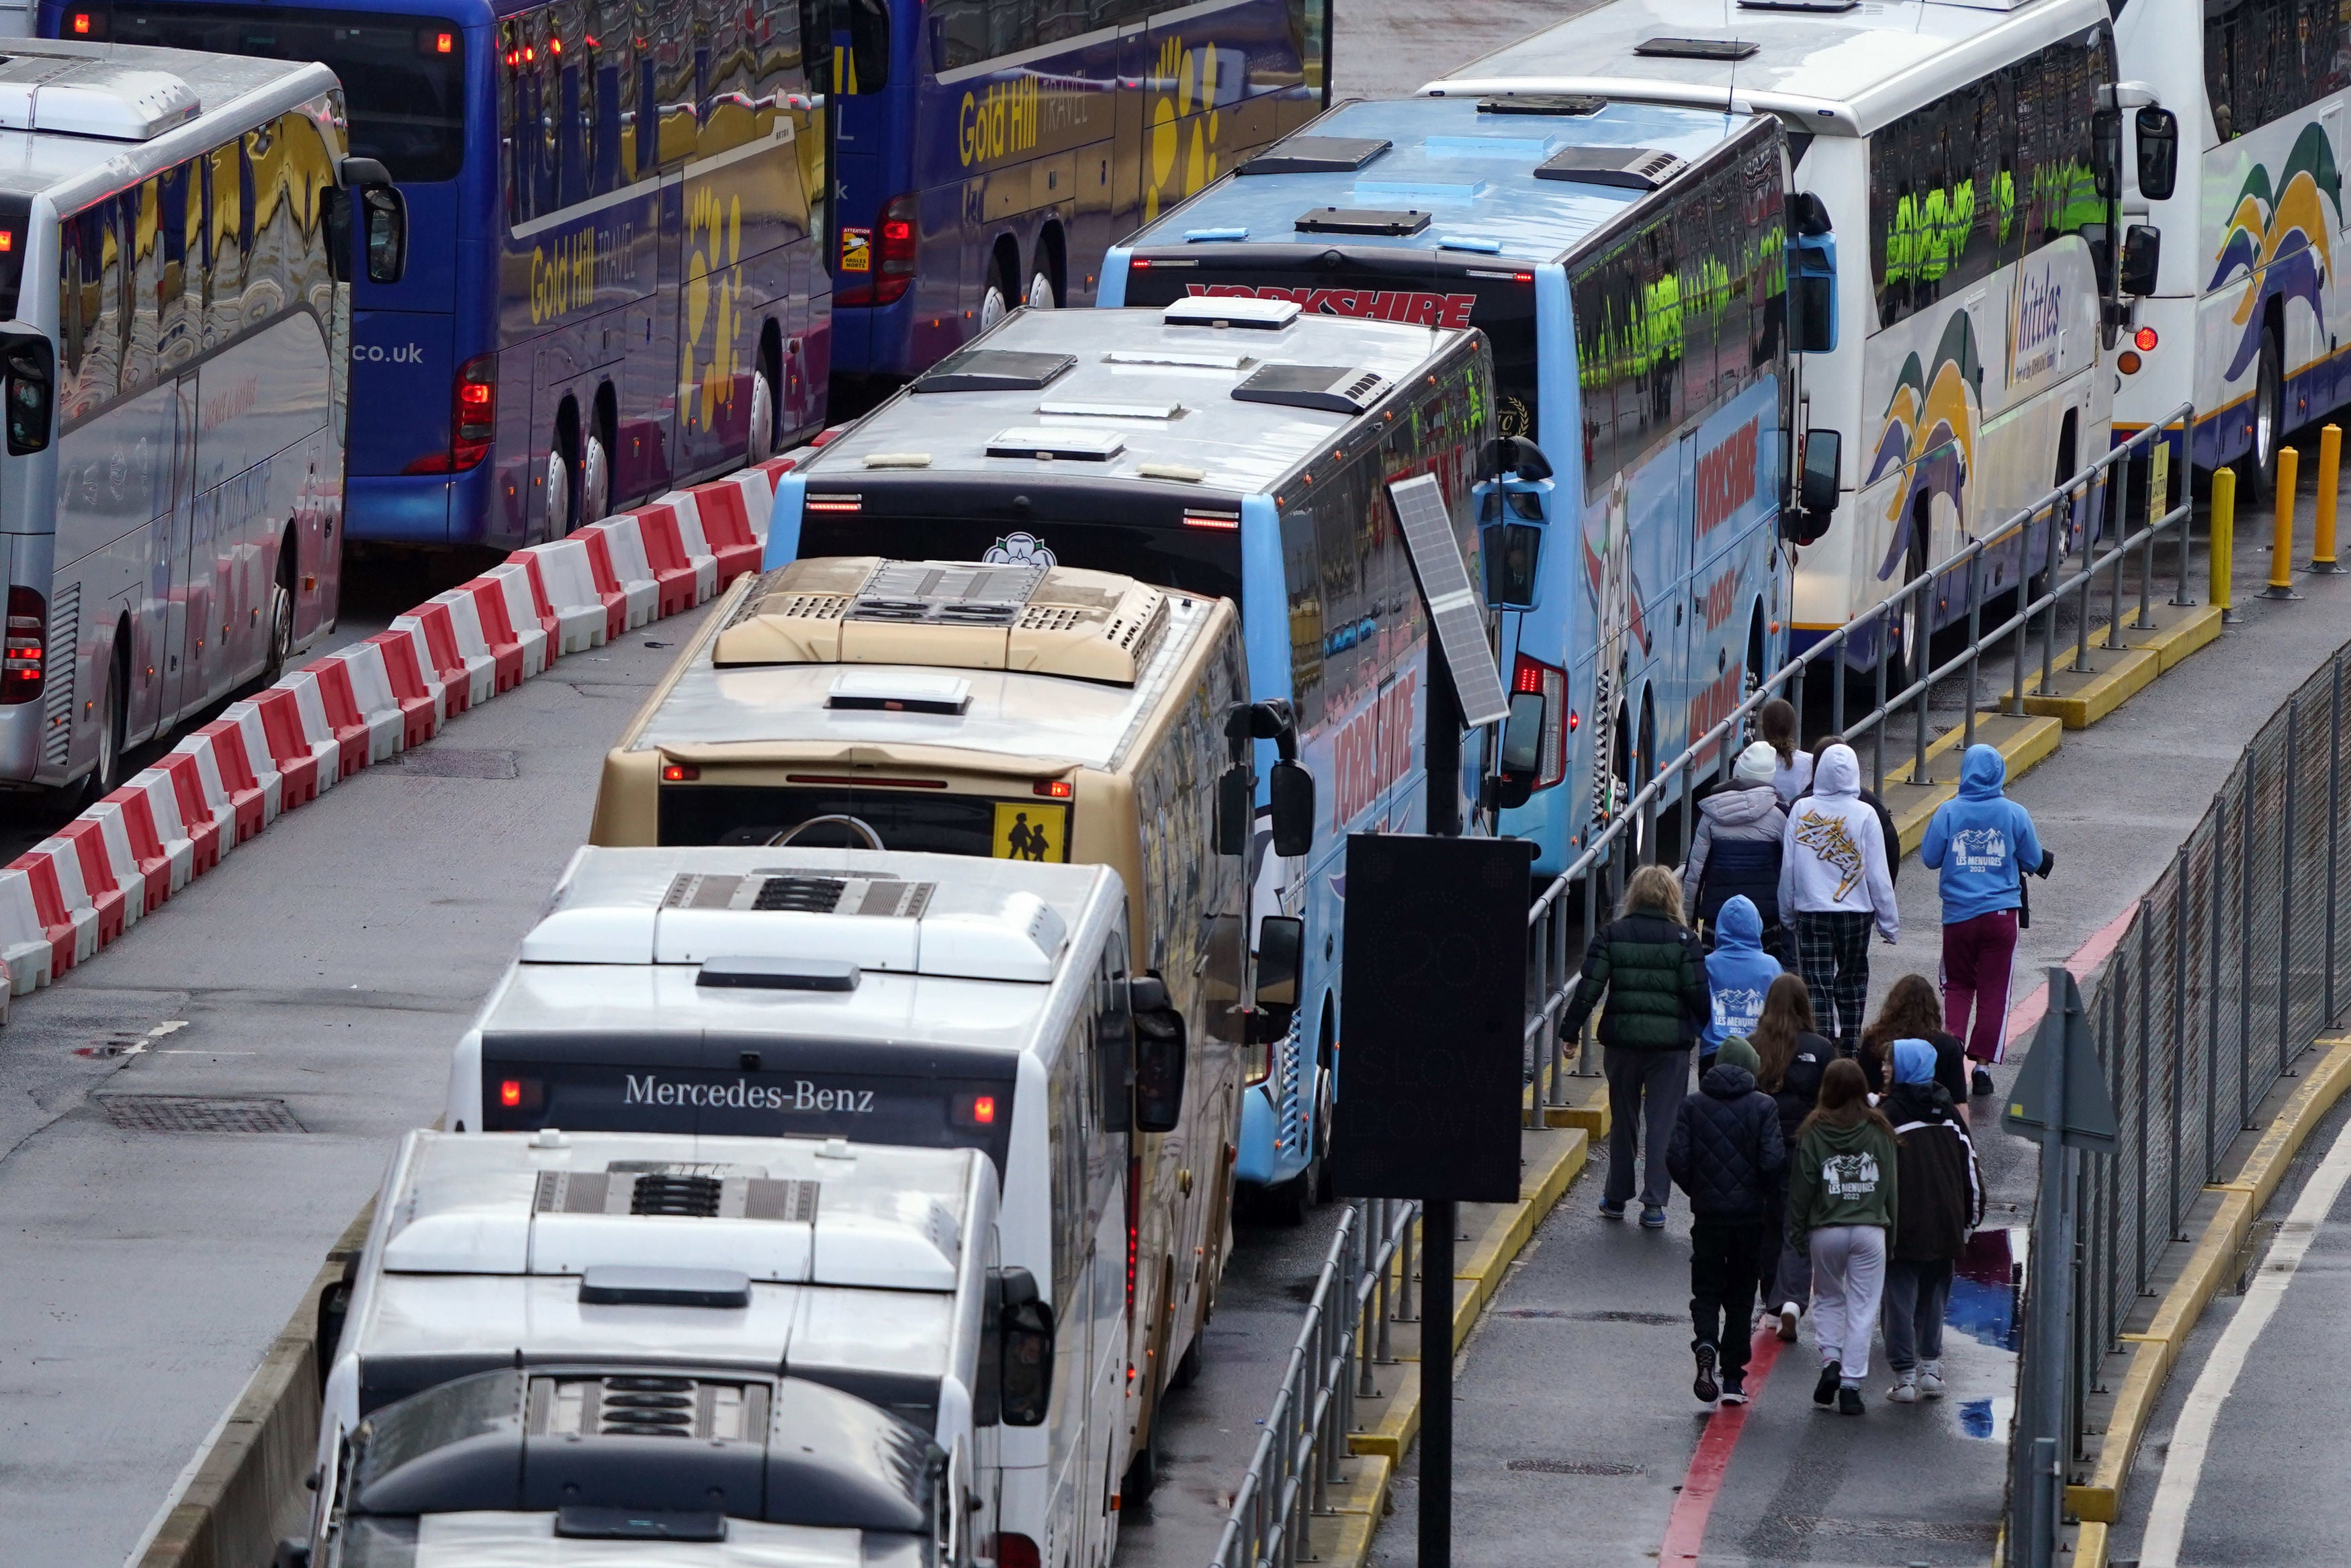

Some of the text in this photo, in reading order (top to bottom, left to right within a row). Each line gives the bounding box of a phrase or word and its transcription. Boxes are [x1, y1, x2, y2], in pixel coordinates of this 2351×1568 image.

[959, 69, 1088, 167] Gold Hill TRAVEL
[531, 220, 635, 325] Gold Hill TRAVEL
[1333, 665, 1417, 837] YORKSHIRE
[1956, 856, 2002, 867] LES MENUIRES
[1714, 1015, 1759, 1027] LES MENUIRE
[623, 1074, 874, 1113] Mercedes-Benz
[1828, 1184, 1840, 1195] LES
